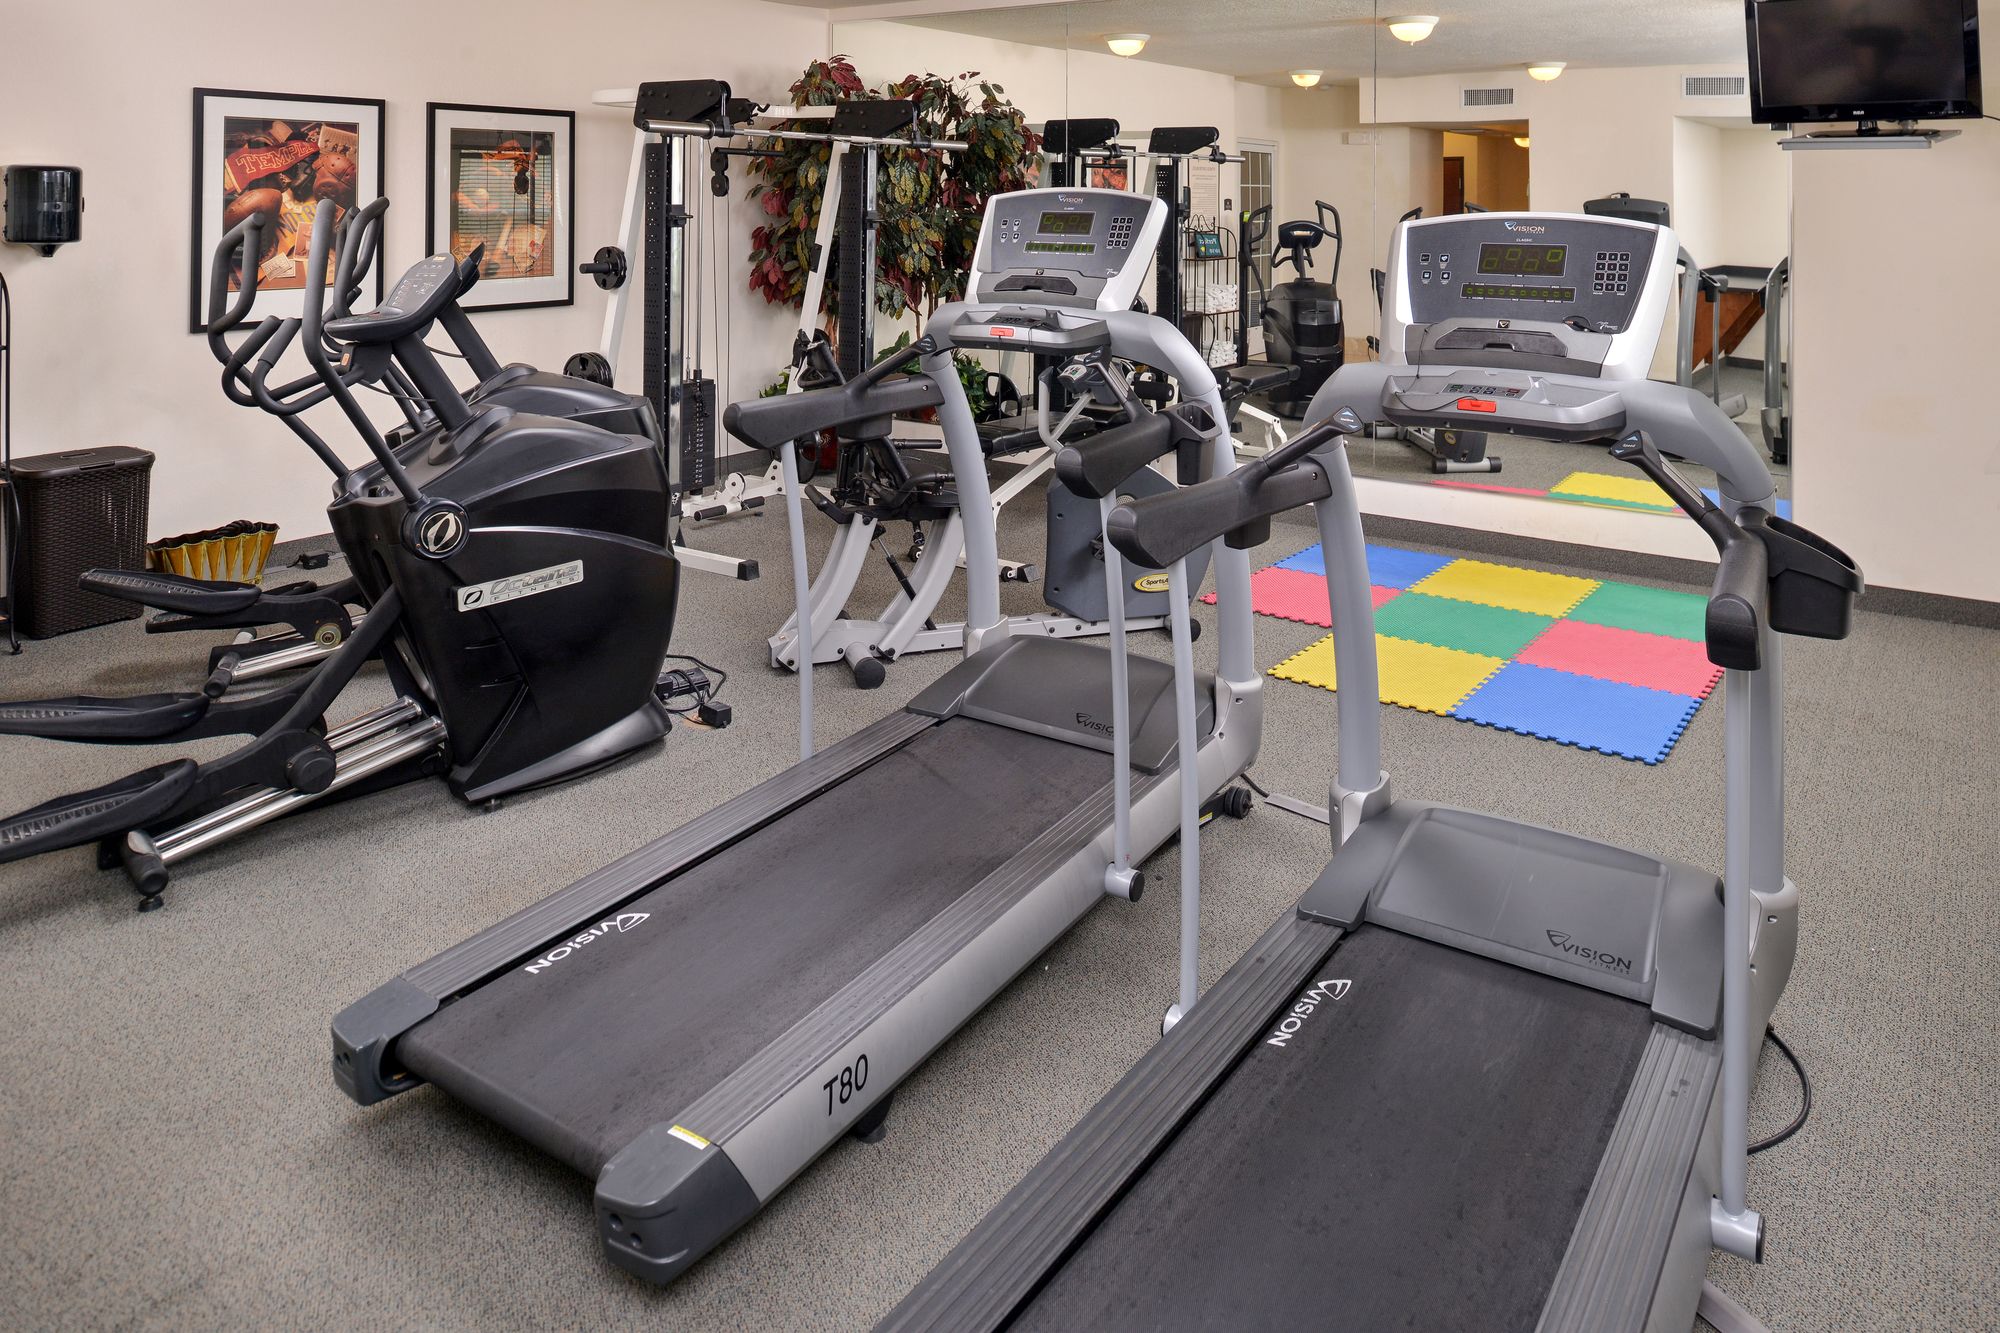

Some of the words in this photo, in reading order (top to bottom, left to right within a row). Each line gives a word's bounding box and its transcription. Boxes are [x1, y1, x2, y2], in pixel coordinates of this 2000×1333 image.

[494, 577, 575, 600] FITNESS
[524, 921, 618, 975] VISION
[1562, 943, 1632, 970] VISION
[1588, 959, 1630, 975] FITNESS
[1266, 989, 1325, 1047] VISION
[823, 1053, 869, 1117] T80
